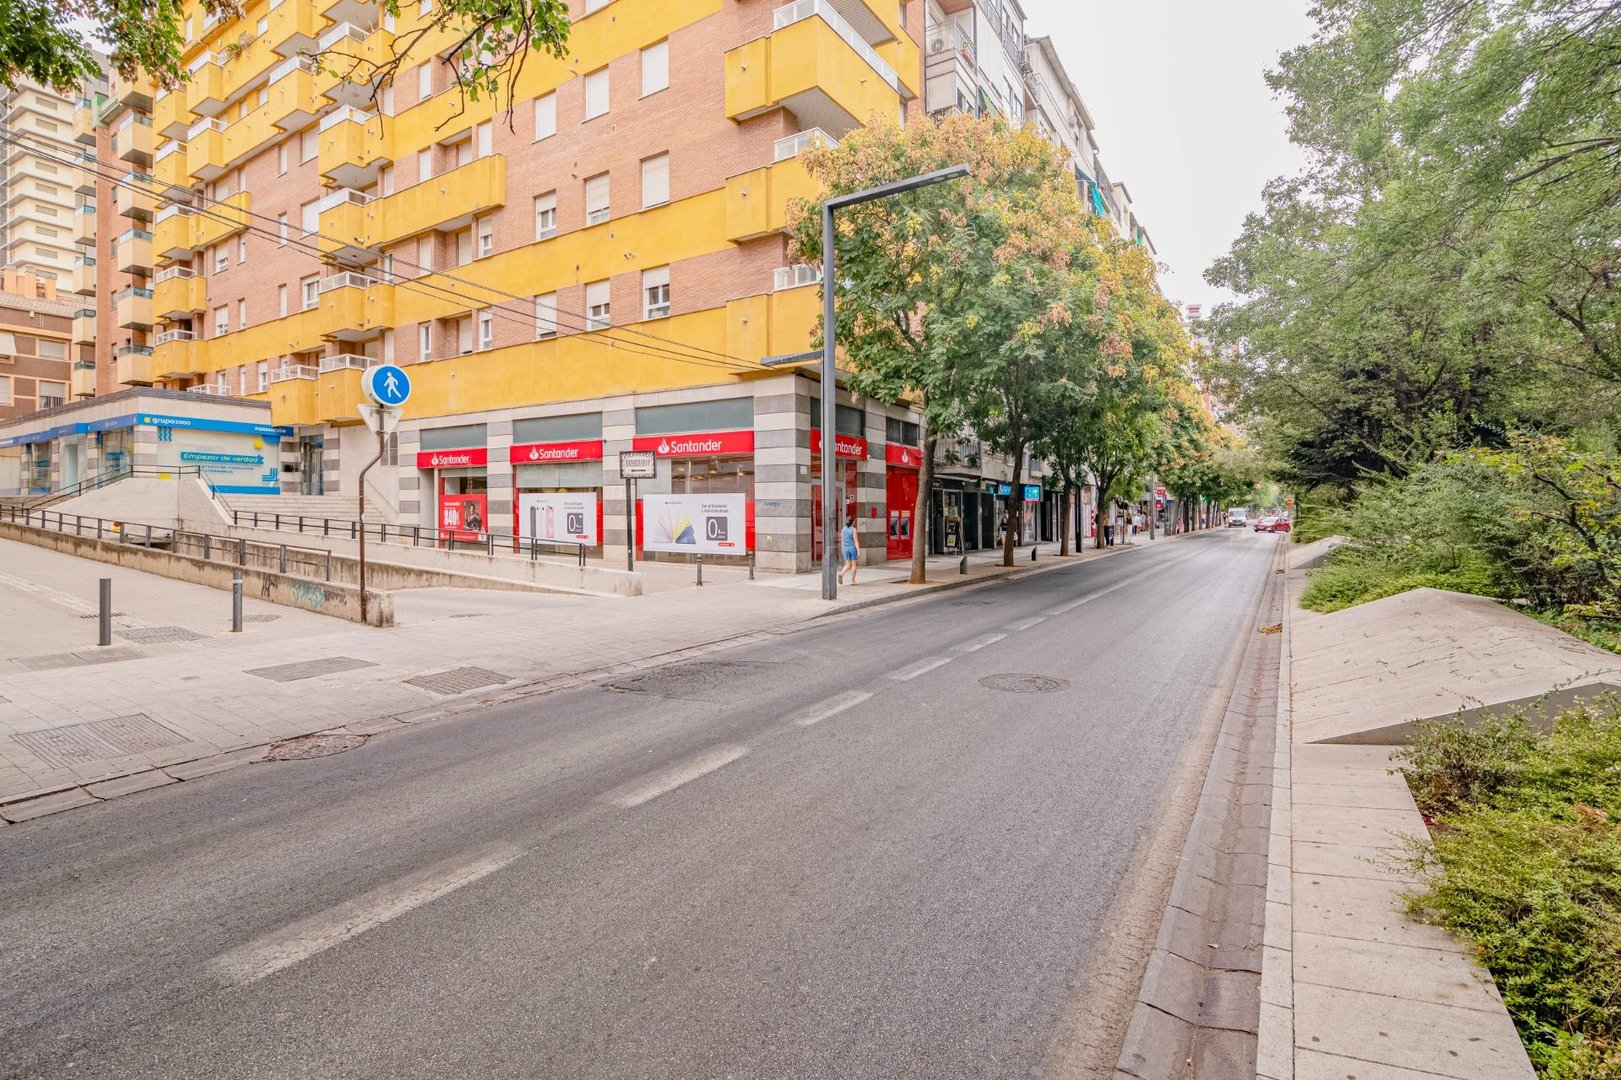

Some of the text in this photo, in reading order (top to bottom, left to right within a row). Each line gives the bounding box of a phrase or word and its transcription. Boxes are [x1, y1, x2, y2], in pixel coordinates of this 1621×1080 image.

[671, 439, 722, 454] Santander
[835, 441, 862, 455] antander
[183, 453, 219, 461] Empezar
[232, 455, 259, 463] verdad
[539, 447, 578, 459] Santander
[438, 455, 470, 465] Santander
